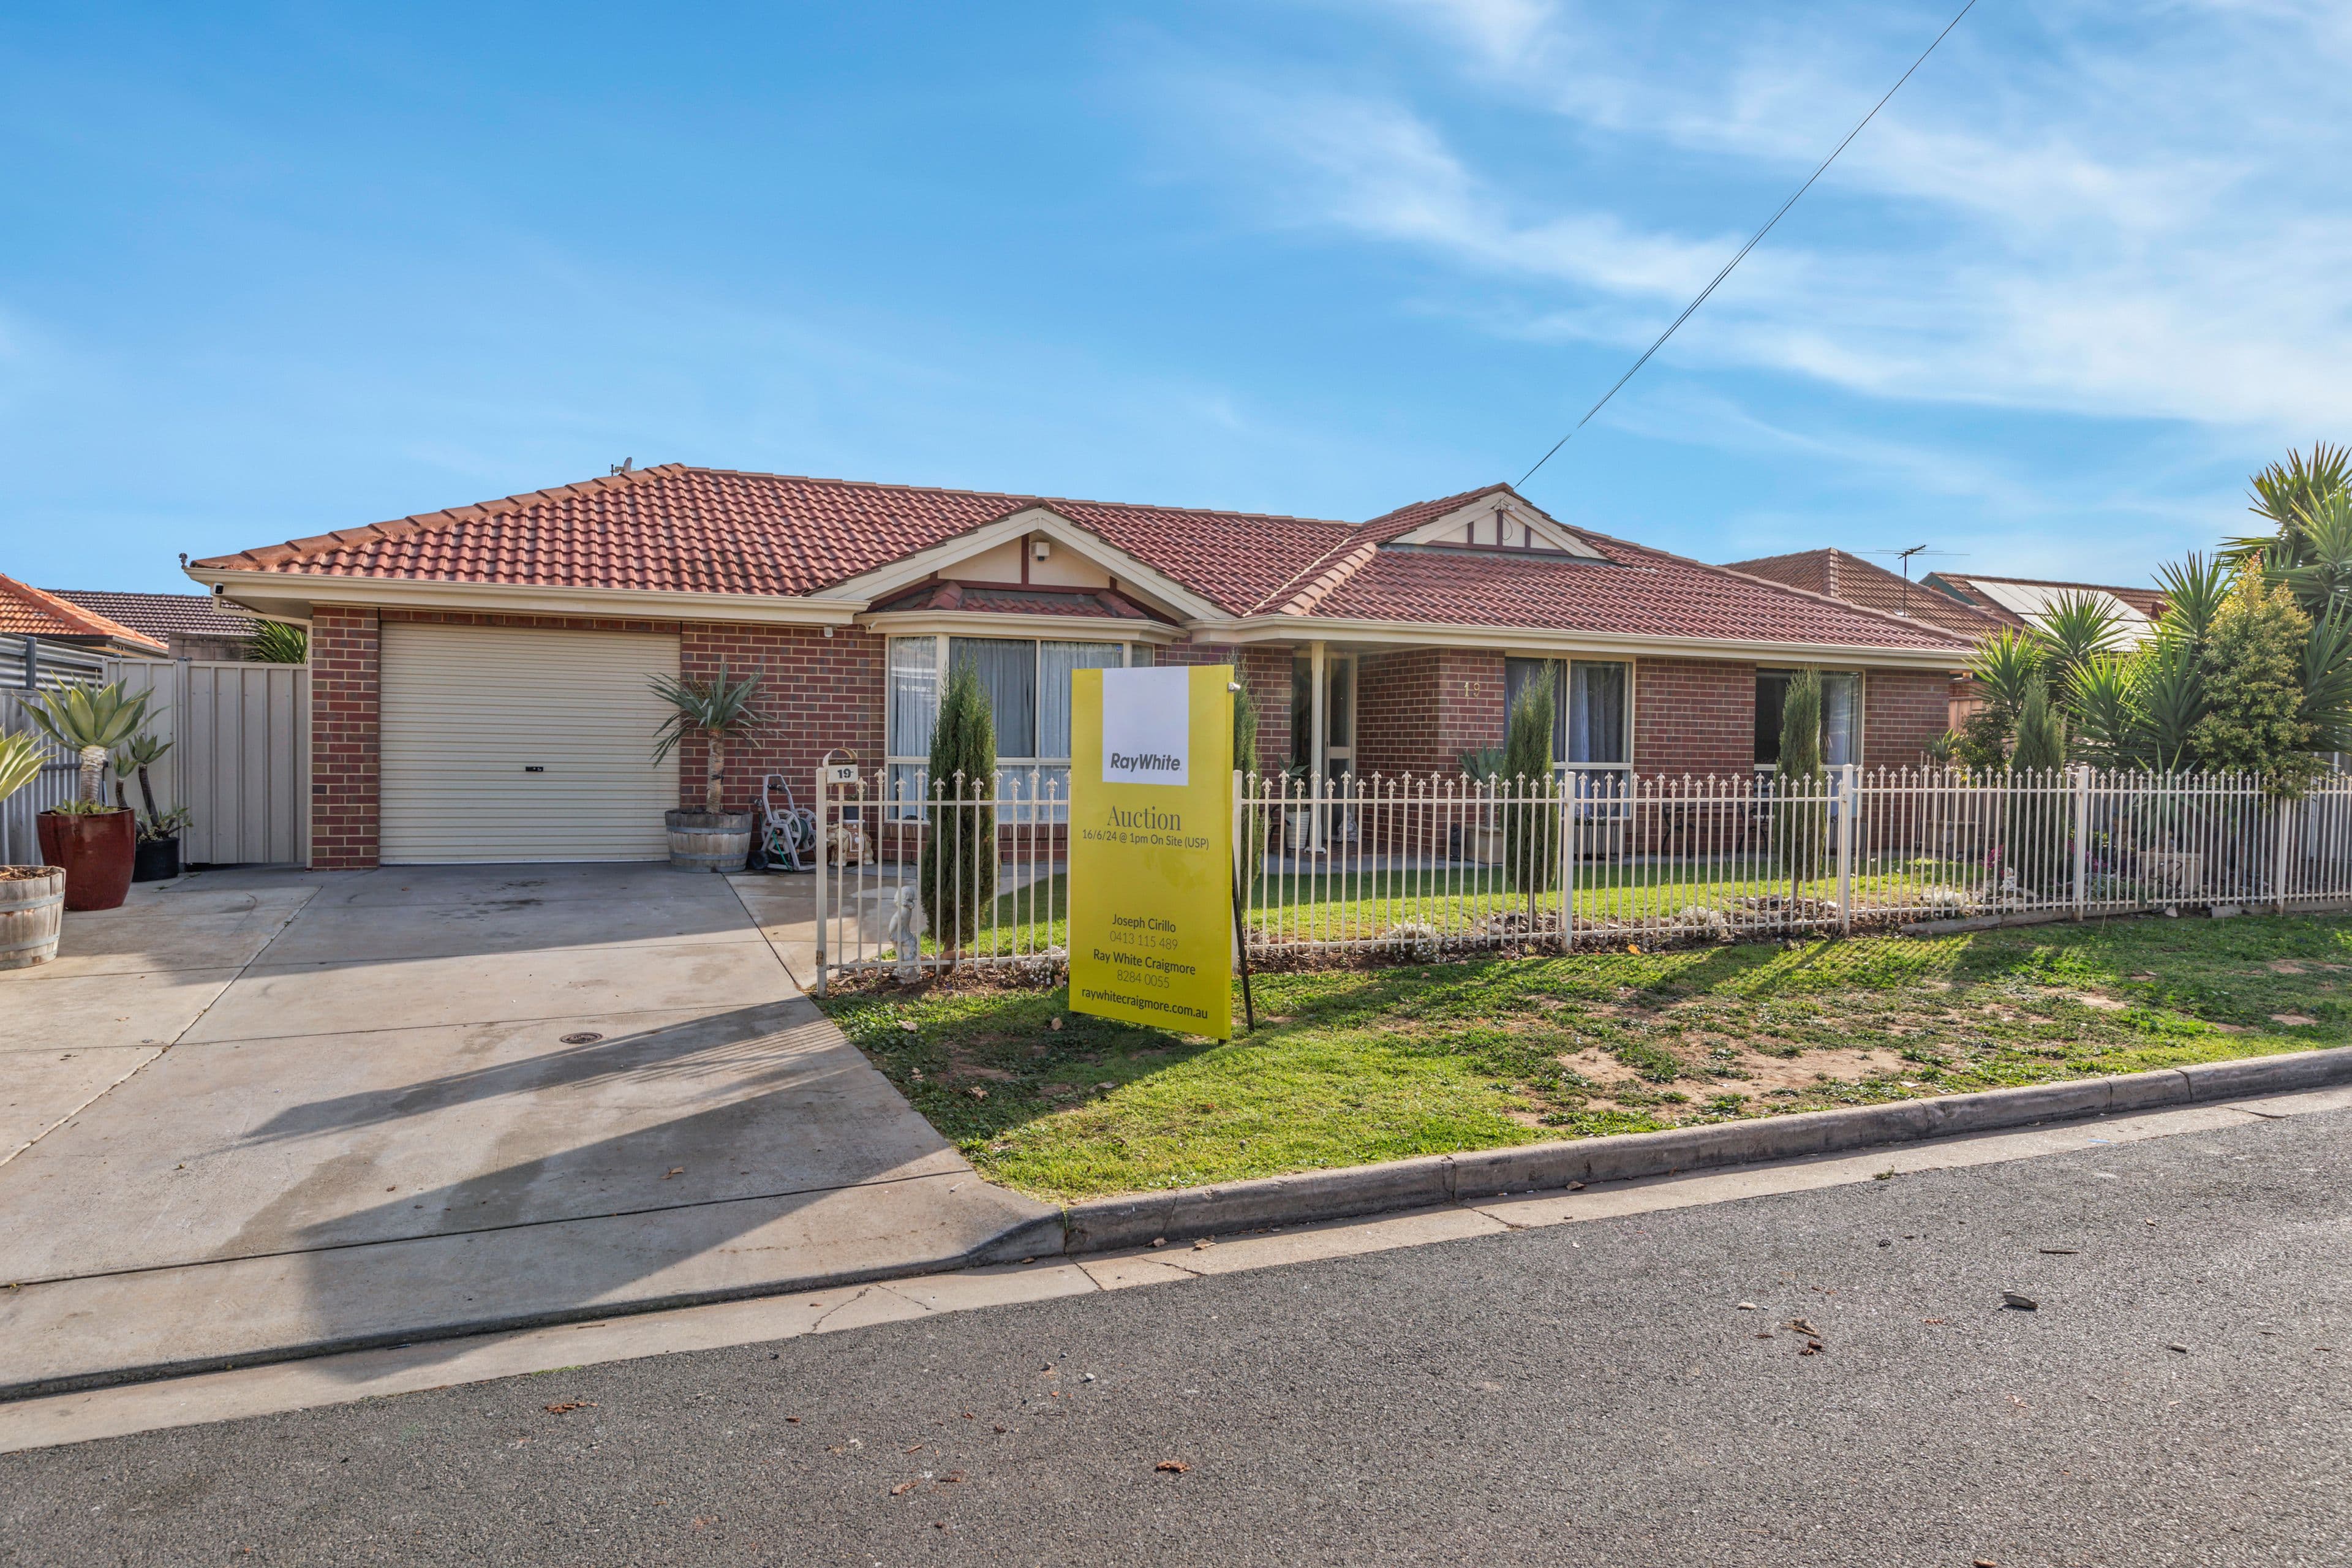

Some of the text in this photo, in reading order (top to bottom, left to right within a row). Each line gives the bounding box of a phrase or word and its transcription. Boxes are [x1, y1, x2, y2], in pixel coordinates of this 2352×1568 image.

[1464, 682, 1480, 697] 19
[837, 768, 852, 778] 19
[1107, 805, 1181, 831] Auction
[1083, 829, 1209, 850] 16/6/24 @ 1pm On Site (USP)
[1112, 914, 1176, 932] Joseph Cirillo
[1110, 930, 1178, 951] 0413 115 489
[1093, 949, 1196, 975] Ray White Craigmore
[1117, 970, 1170, 989] 8284 0055
[1082, 988, 1208, 1019] raywhitecraigmore.com.au
